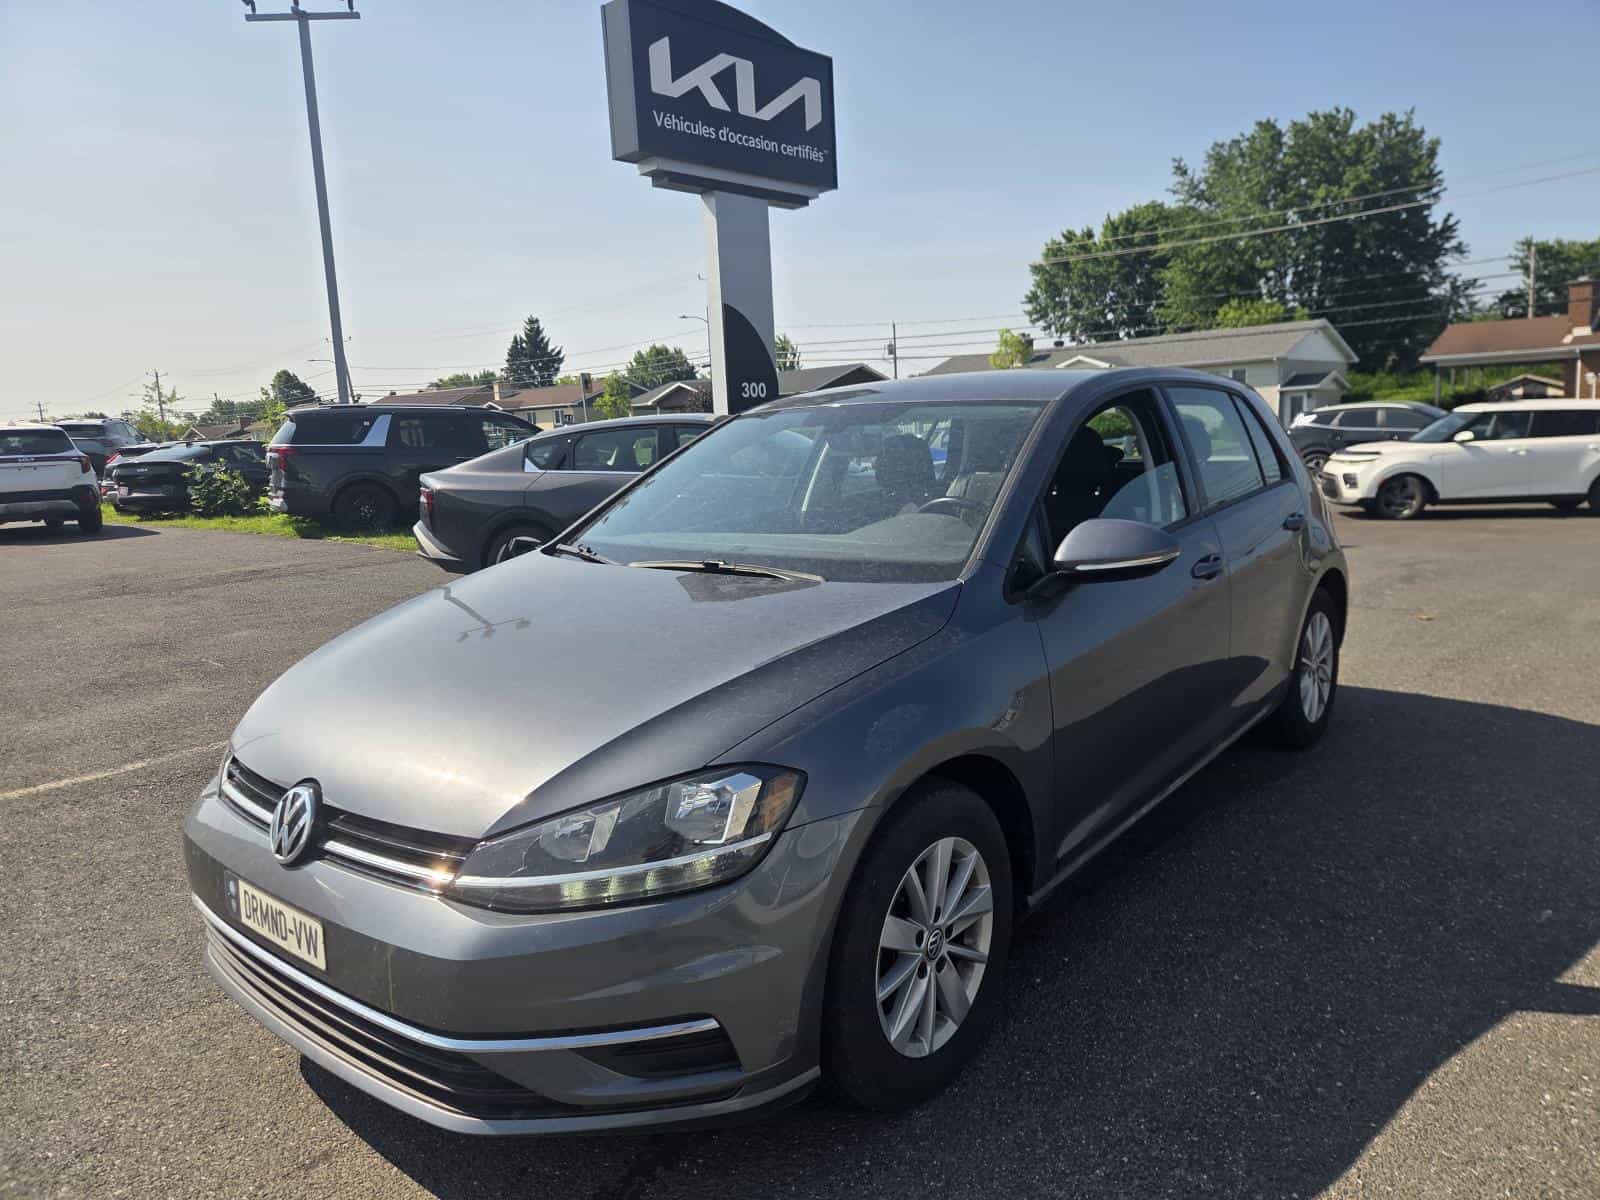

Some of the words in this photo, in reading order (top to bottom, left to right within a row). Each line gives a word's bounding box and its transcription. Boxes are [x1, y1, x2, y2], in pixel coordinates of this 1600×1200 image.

[652, 110, 716, 139] Véhicules
[718, 127, 779, 154] d'occasion
[780, 143, 824, 163] certifiés
[741, 382, 767, 398] 300
[243, 889, 319, 958] DRMND-VW
